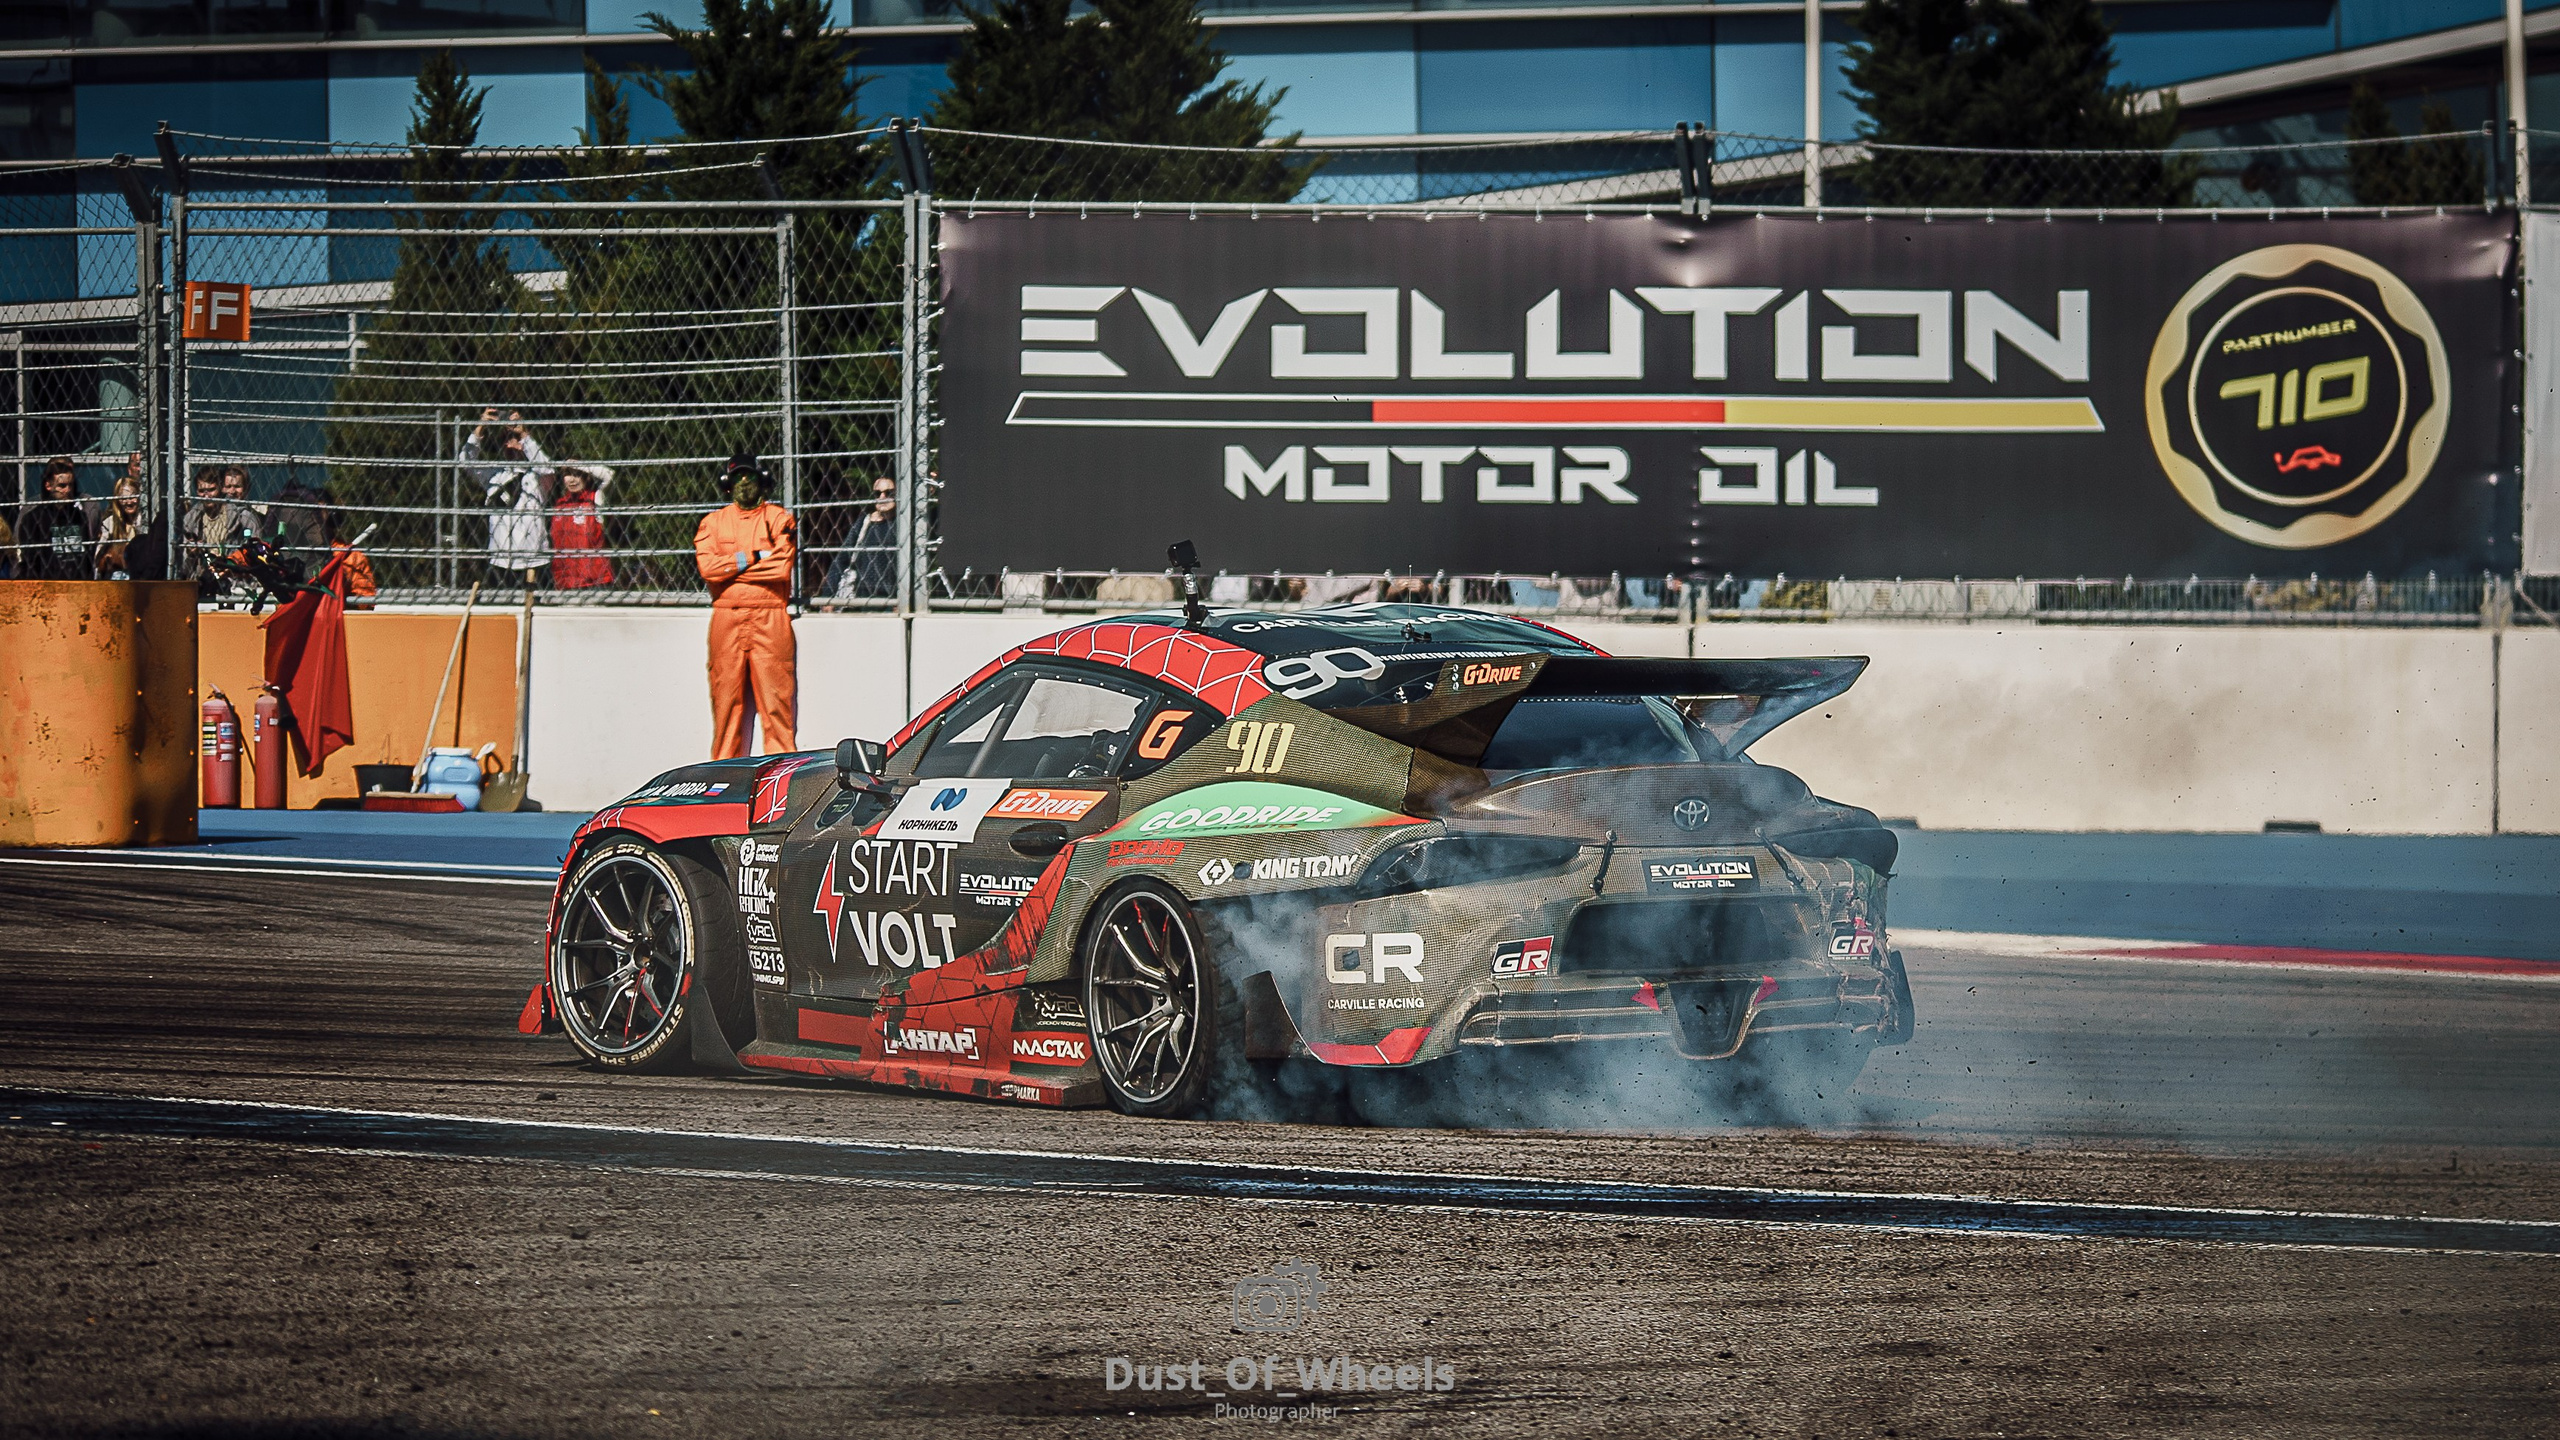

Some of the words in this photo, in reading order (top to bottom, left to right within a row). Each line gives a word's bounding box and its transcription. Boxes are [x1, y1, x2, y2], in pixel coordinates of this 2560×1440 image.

[1020, 285, 2090, 383] EVOLUTION
[2222, 318, 2357, 354] PARTNUMBER
[2219, 355, 2371, 431] 710
[1223, 445, 1640, 504] MOTOR
[1699, 446, 1879, 507] OIL
[1263, 647, 1386, 700] 90
[1138, 709, 1193, 760] G
[898, 819, 959, 832] НОРНИКЕЛЬ
[1139, 805, 1343, 832] GOODRIDE
[848, 839, 959, 897] START
[1251, 857, 1301, 880] KING
[1303, 854, 1359, 878] TONY
[1650, 861, 1751, 877] EVOLUTION
[738, 866, 770, 897] HGK
[1672, 880, 1713, 889] MOTOR
[1717, 880, 1736, 888] OIL
[738, 895, 770, 915] RACING
[975, 895, 1012, 907] MOTOR
[750, 924, 772, 938] VRC
[848, 910, 958, 970] VOLT
[1831, 935, 1874, 954] GR
[1325, 932, 1424, 984] CR
[1493, 949, 1549, 973] GR
[1327, 998, 1376, 1010] CARVILLE
[1378, 997, 1425, 1009] RACING
